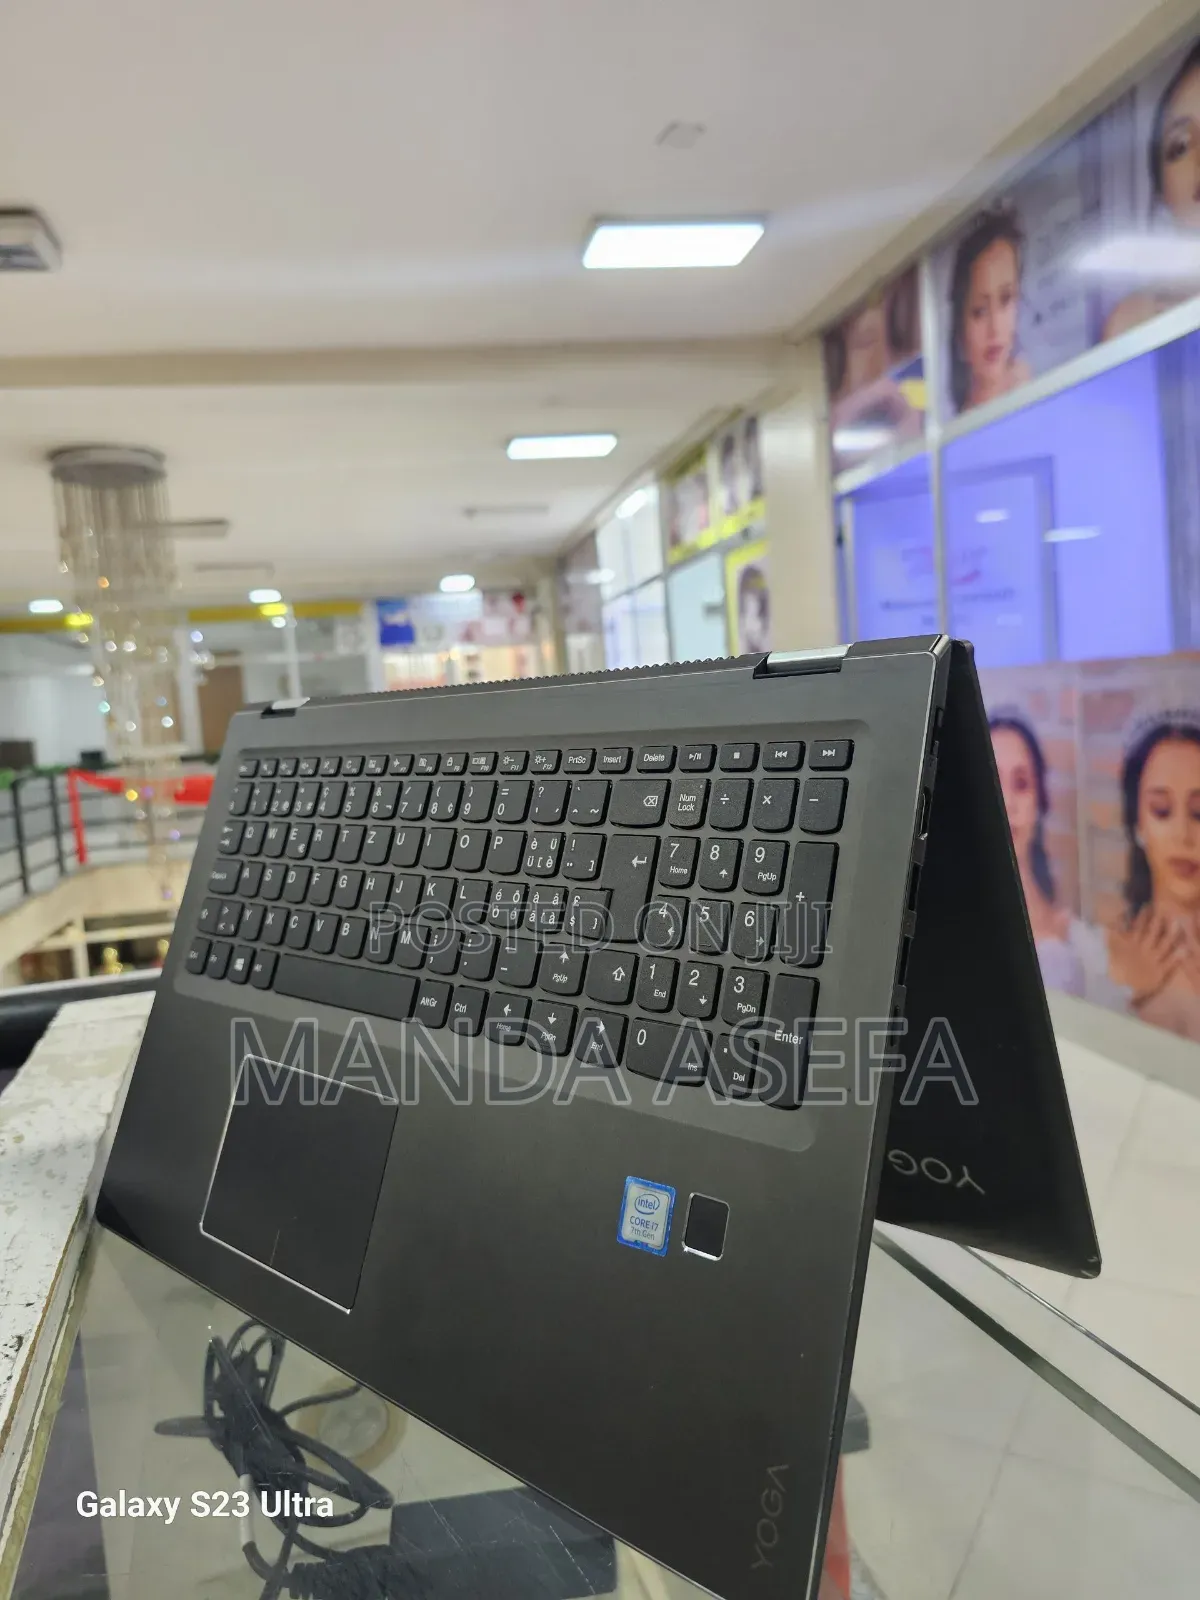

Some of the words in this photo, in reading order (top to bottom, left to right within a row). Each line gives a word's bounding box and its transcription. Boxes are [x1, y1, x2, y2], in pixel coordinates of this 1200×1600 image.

[568, 756, 586, 764] PrtSc
[604, 756, 622, 764] Insert
[644, 754, 665, 762] Delete
[376, 786, 382, 796] &
[436, 786, 440, 796] (
[469, 786, 474, 797] )
[538, 786, 544, 798] ?
[345, 802, 352, 813] 5
[372, 802, 378, 813] 6
[402, 802, 408, 813] 7
[431, 802, 438, 814] 8
[464, 803, 471, 814] 9
[678, 803, 694, 812] Lock
[269, 828, 278, 839] W
[290, 829, 298, 840] E
[314, 829, 323, 842] R
[342, 830, 350, 842] T
[367, 831, 376, 844] Z
[396, 833, 405, 846] U
[494, 836, 503, 849] P
[531, 838, 538, 850] è
[571, 839, 575, 851] !
[669, 843, 680, 858] 7
[710, 845, 720, 860] 8
[754, 847, 765, 863] 9
[546, 856, 553, 868] è
[265, 869, 272, 882] S
[670, 866, 688, 874] Home
[287, 871, 296, 883] D
[312, 873, 321, 885] F
[339, 875, 348, 888] G
[758, 872, 777, 881] PgUp
[366, 878, 375, 890] H
[396, 880, 403, 893] J
[426, 883, 436, 896] K
[460, 886, 466, 899] L
[658, 903, 668, 918] 4
[700, 906, 710, 923] 5
[266, 913, 274, 925] X
[290, 916, 298, 928] C
[744, 910, 755, 927] 6
[316, 919, 324, 932] V
[342, 923, 350, 936] B
[400, 931, 411, 944] M
[650, 964, 656, 979] 1
[552, 974, 568, 984] PgUp
[688, 970, 700, 986] 2
[734, 976, 745, 993] 3
[654, 990, 666, 998] End
[420, 997, 437, 1007] AltGr
[454, 1003, 467, 1013] Ctrl
[737, 1003, 756, 1013] PgDn
[637, 1030, 647, 1046] 0
[774, 1030, 803, 1044] Enter
[688, 1063, 698, 1072] Ins
[733, 1072, 745, 1082] Del
[630, 1216, 650, 1228] CORE
[642, 1229, 655, 1240] Gen
[751, 1464, 790, 1569] YOGA
